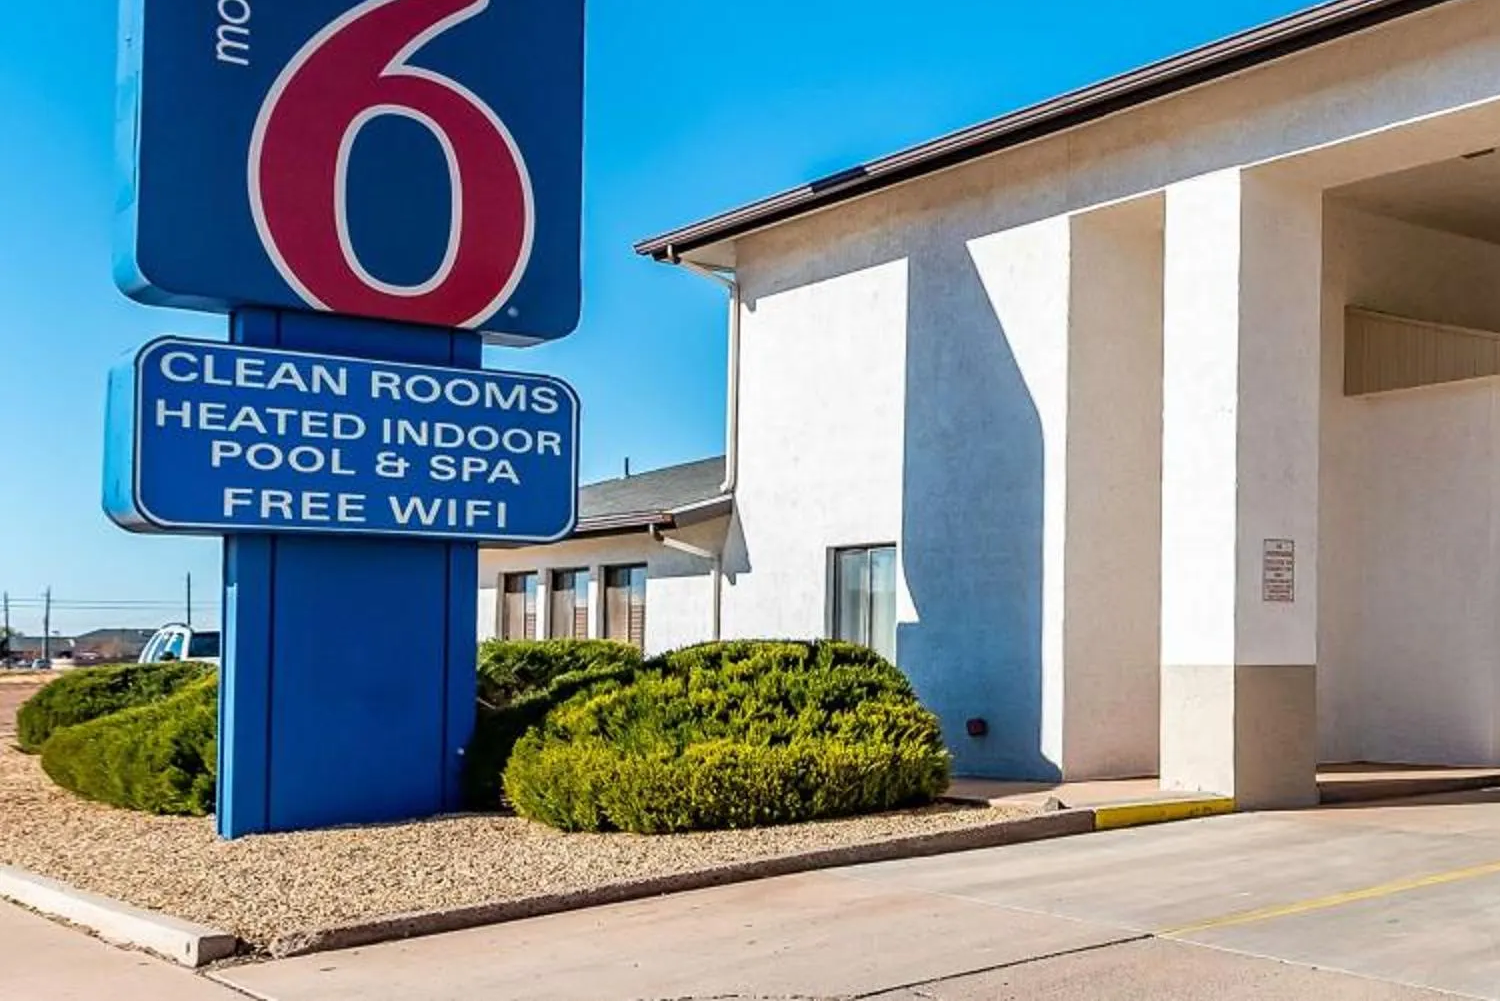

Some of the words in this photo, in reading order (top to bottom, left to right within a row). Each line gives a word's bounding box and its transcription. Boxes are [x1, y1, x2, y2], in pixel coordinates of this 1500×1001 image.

[159, 352, 347, 396] CLEAN
[371, 370, 559, 415] ROOMS
[155, 400, 366, 440] HEATED
[383, 418, 562, 456] INDOOR
[211, 440, 356, 476] POOL
[375, 452, 409, 479] &
[429, 455, 521, 485] SPA
[222, 488, 367, 522] FREE
[389, 497, 507, 529] WIFI
